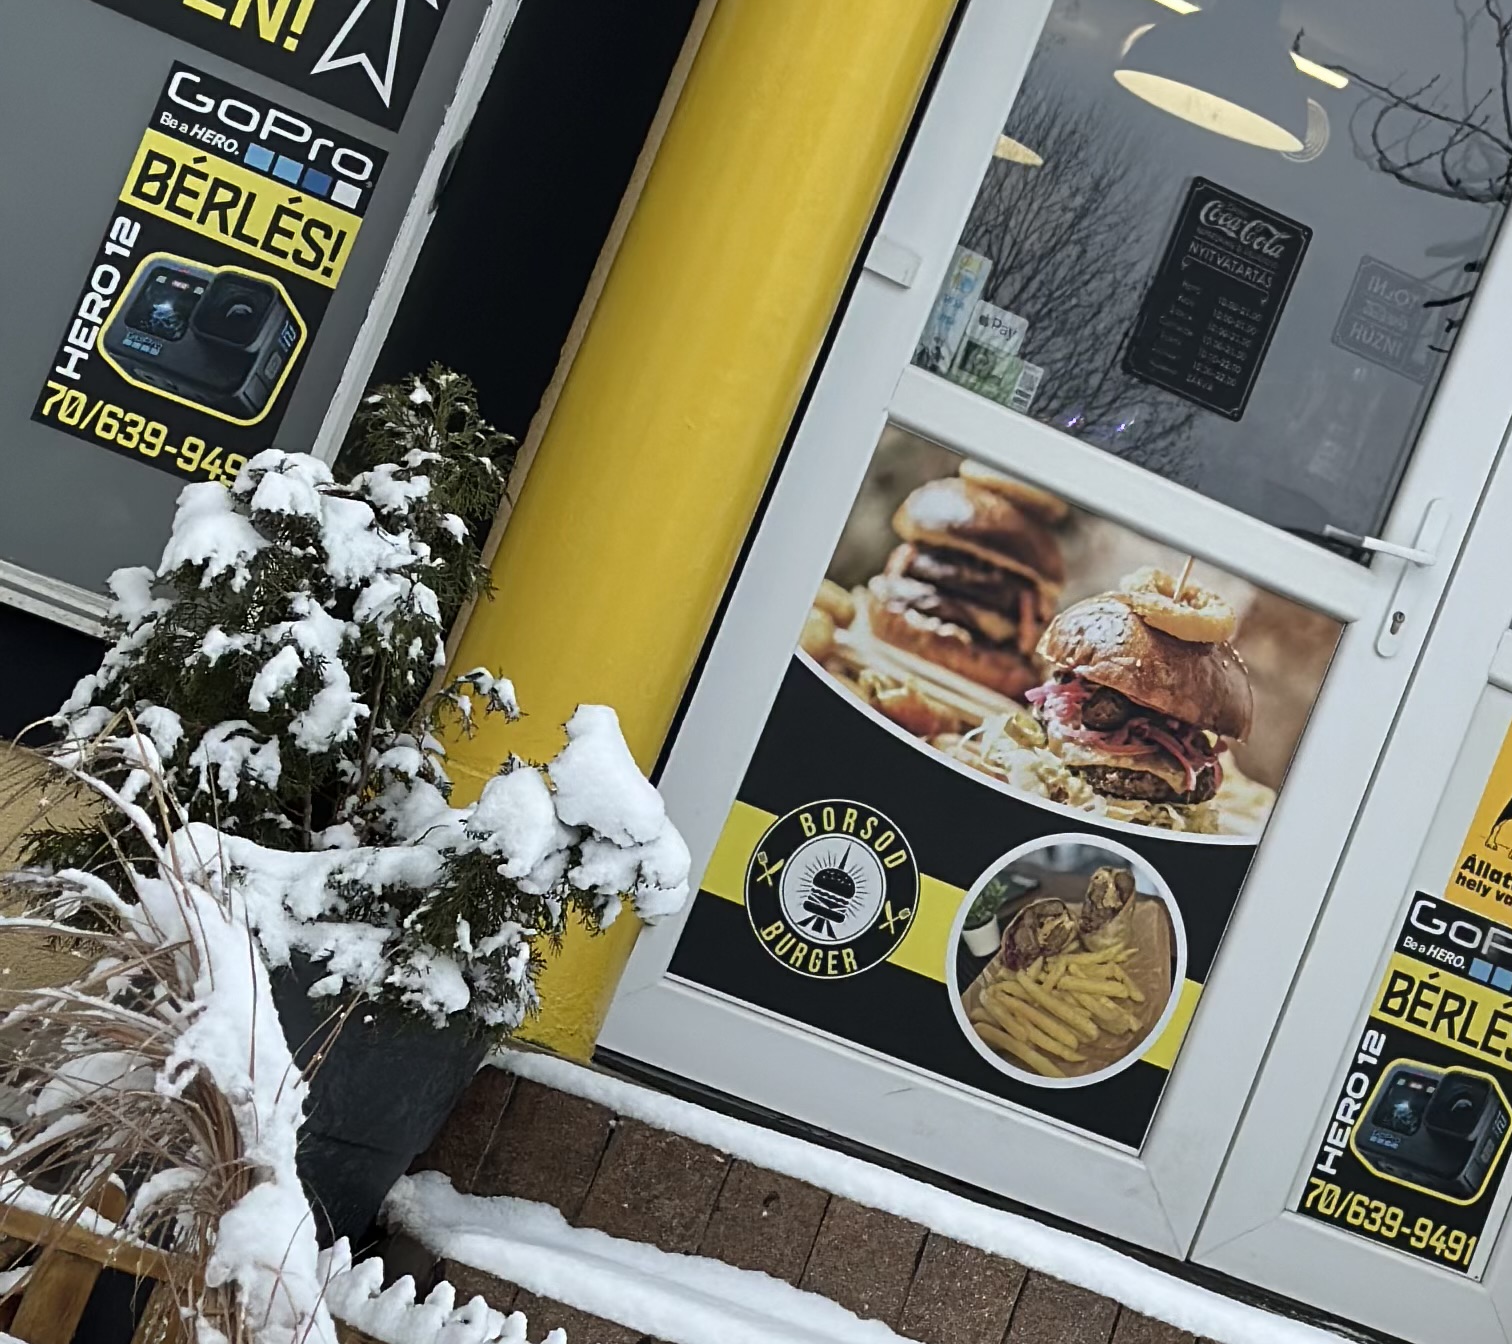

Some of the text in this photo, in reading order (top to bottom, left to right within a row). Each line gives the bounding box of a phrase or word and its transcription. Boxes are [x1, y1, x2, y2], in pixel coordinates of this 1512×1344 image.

[159, 111, 240, 156] Be a HERO.
[167, 70, 374, 182] GoPro
[130, 147, 350, 277] BÉRLÉS!
[55, 216, 142, 381] HERO 12
[41, 379, 249, 488] 70/639-949
[799, 806, 908, 870] BORSOD
[1454, 871, 1494, 900] hely
[759, 919, 859, 976] BURGER
[1402, 935, 1418, 951] Be
[1425, 943, 1466, 970] HERO.
[1316, 1028, 1387, 1176] HERO 12
[1305, 1177, 1478, 1267] 70/639-9491
